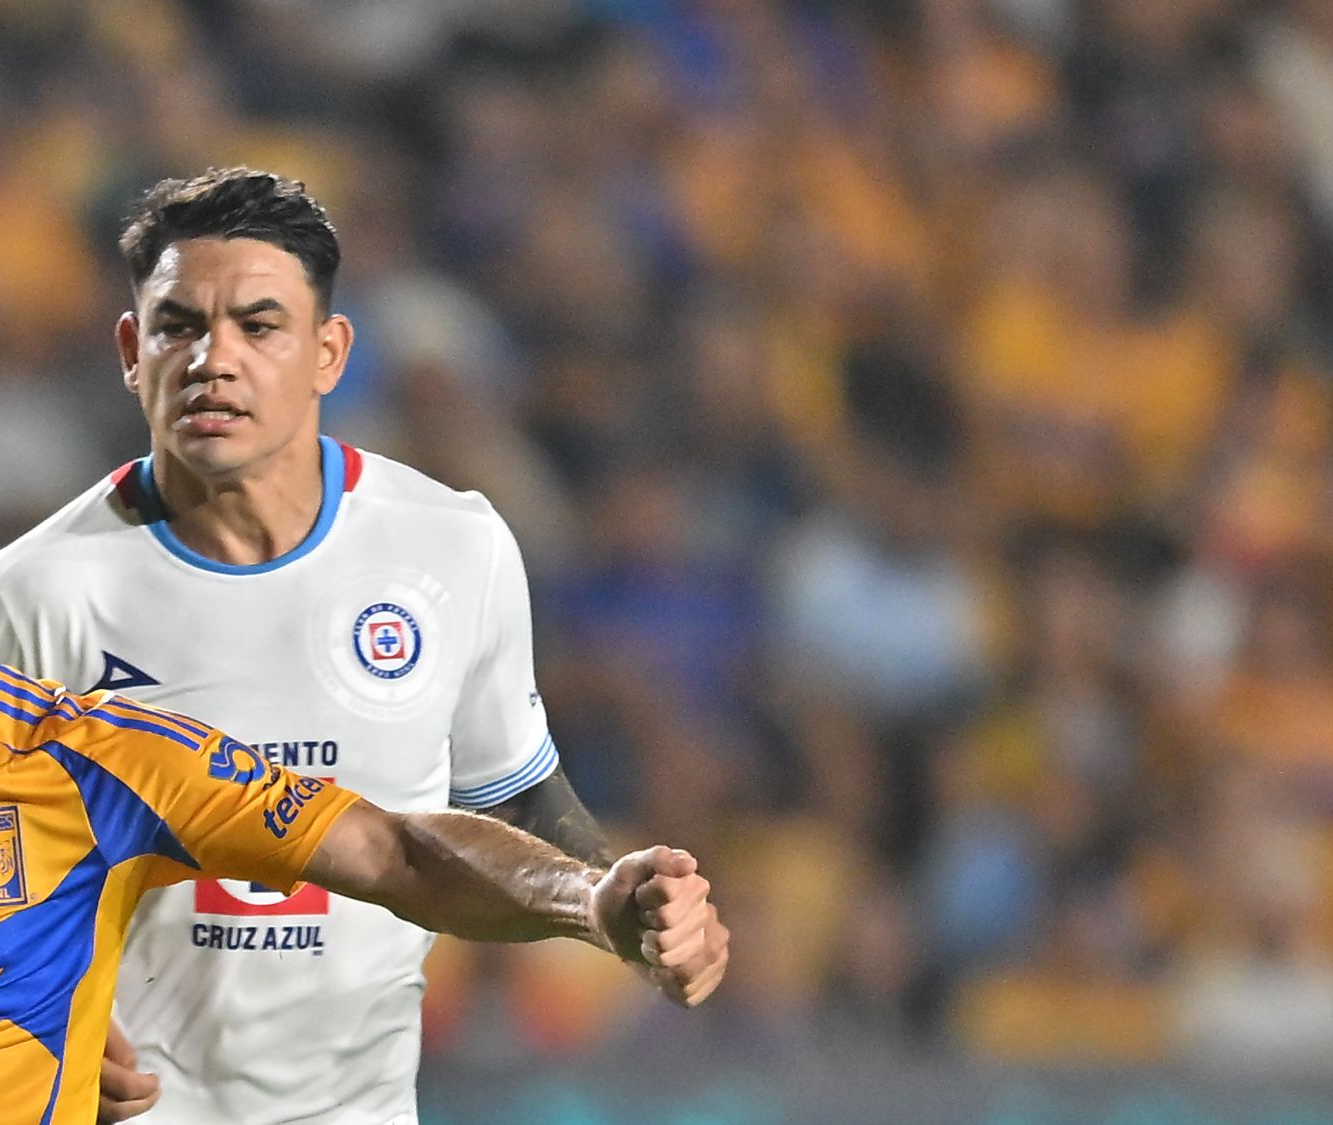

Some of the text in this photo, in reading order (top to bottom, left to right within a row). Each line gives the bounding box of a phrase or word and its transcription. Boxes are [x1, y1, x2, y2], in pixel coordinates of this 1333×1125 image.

[251, 740, 338, 767] ENTO
[191, 923, 325, 951] CRUZ AZUL
